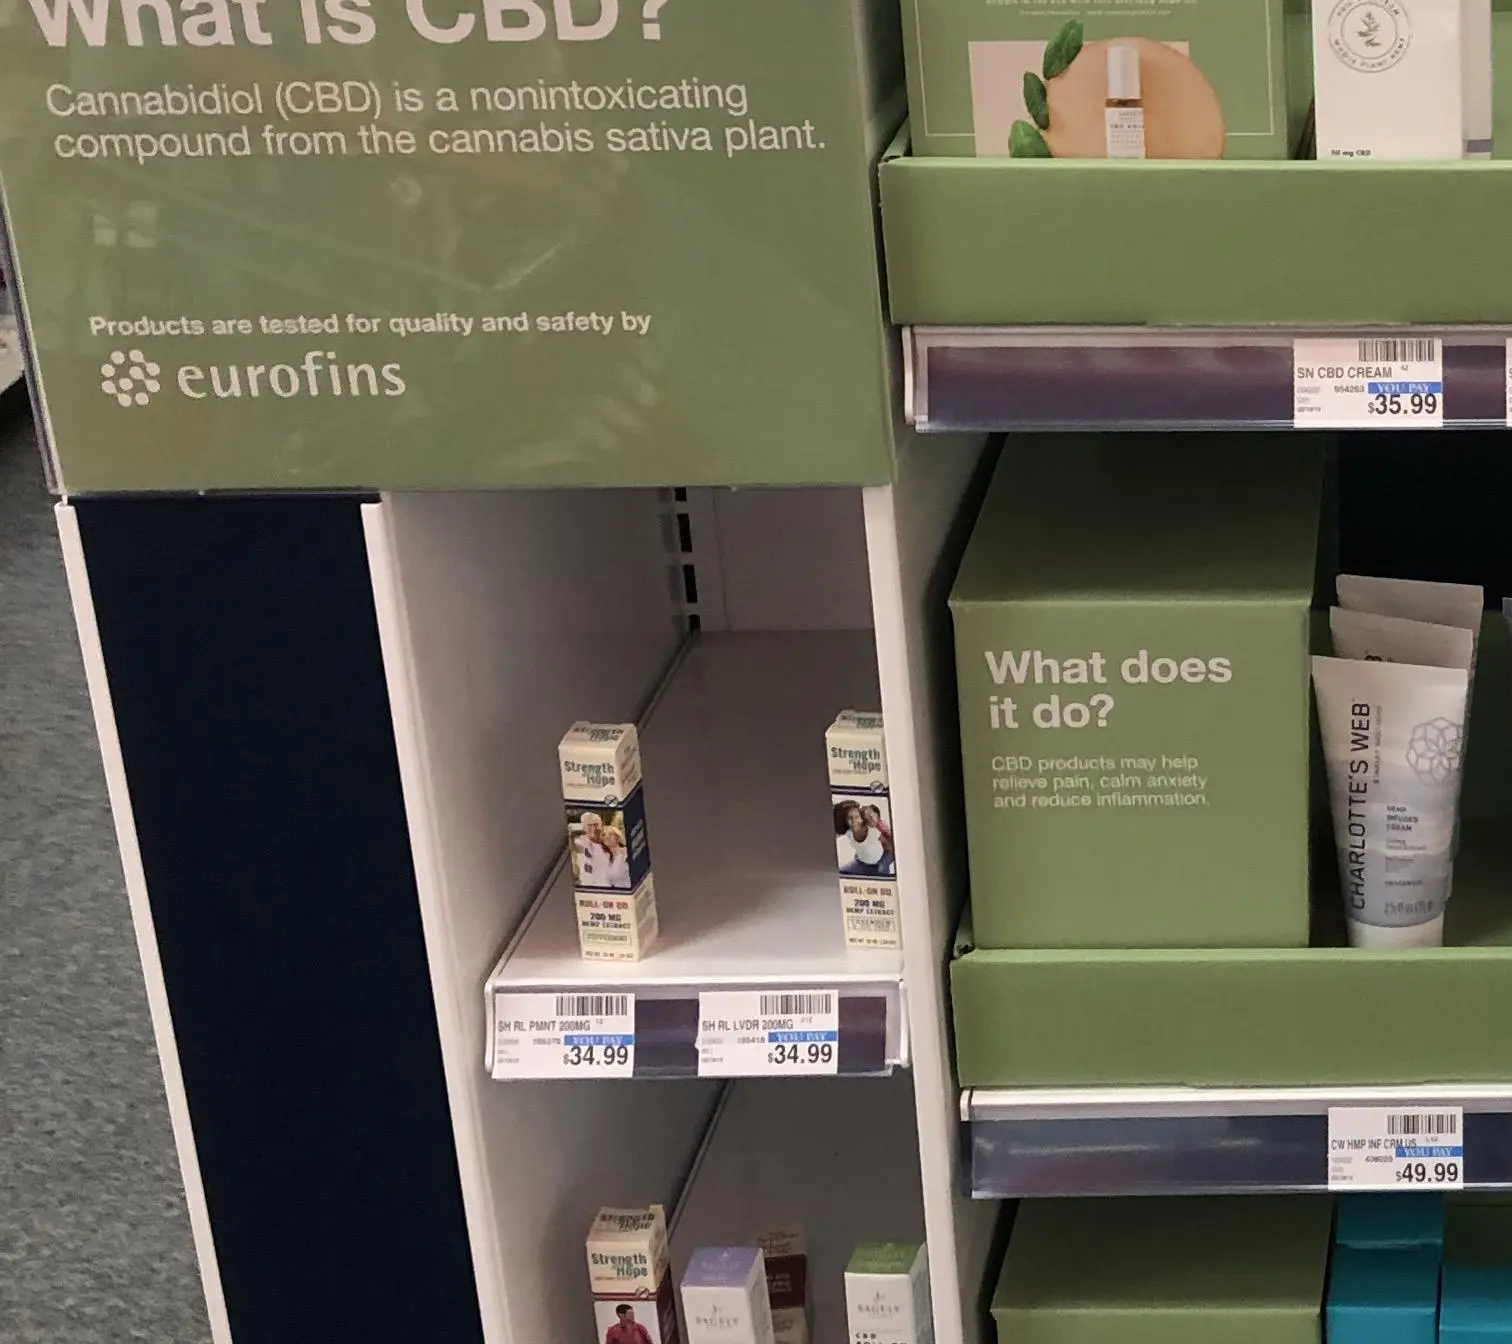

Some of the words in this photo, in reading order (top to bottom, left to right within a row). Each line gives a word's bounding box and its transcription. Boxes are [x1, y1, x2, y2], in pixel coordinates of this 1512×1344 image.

[45, 82, 262, 118] Cannabidiol
[274, 82, 382, 123] (CBD)
[394, 85, 425, 113] is
[436, 90, 458, 113] a
[470, 78, 747, 118] nonintoxicating
[54, 124, 251, 165] compound
[262, 123, 347, 157] from
[357, 123, 416, 156] the
[428, 121, 595, 156] cannabis
[606, 120, 713, 154] sativa
[724, 118, 826, 158] plant.
[89, 315, 205, 337] Products
[212, 317, 252, 336] are
[259, 313, 339, 334] tested
[345, 312, 382, 334] for
[388, 312, 474, 337] quality
[482, 311, 530, 333] and
[536, 310, 614, 336] safety
[621, 309, 652, 336] by
[176, 351, 407, 400] eurofins
[1297, 367, 1315, 380] SN
[1317, 366, 1339, 379] CBD
[1341, 366, 1393, 379] CREAM
[1368, 394, 1438, 415] $35.99
[985, 650, 1107, 685] What
[1121, 649, 1233, 684] does
[989, 695, 1019, 729] it
[1032, 694, 1114, 728] do?
[1351, 702, 1370, 752] WEB
[831, 747, 880, 761] Strength
[564, 760, 615, 775] Strength
[853, 759, 881, 772] Hope
[992, 756, 1032, 771] CBD
[1038, 756, 1115, 773] products
[1121, 757, 1156, 771] may
[1161, 755, 1199, 770] help
[586, 774, 616, 787] Hope
[993, 775, 1047, 789] relieve
[1053, 775, 1094, 791] pain,
[1100, 774, 1141, 788] calm
[1147, 774, 1208, 790] anxiety
[994, 794, 1026, 808] and
[1032, 794, 1091, 808] reduce
[1097, 792, 1210, 807] inflammation.
[1350, 761, 1369, 910] CHARLOTTE'S
[559, 1020, 591, 1031] 200MG
[762, 1019, 794, 1030] 200MG
[563, 1046, 629, 1066] $34.99
[768, 1044, 832, 1064] $34.99
[1396, 1162, 1458, 1183] $49.99
[591, 1253, 647, 1266] Strength
[616, 1265, 648, 1280] Hope
